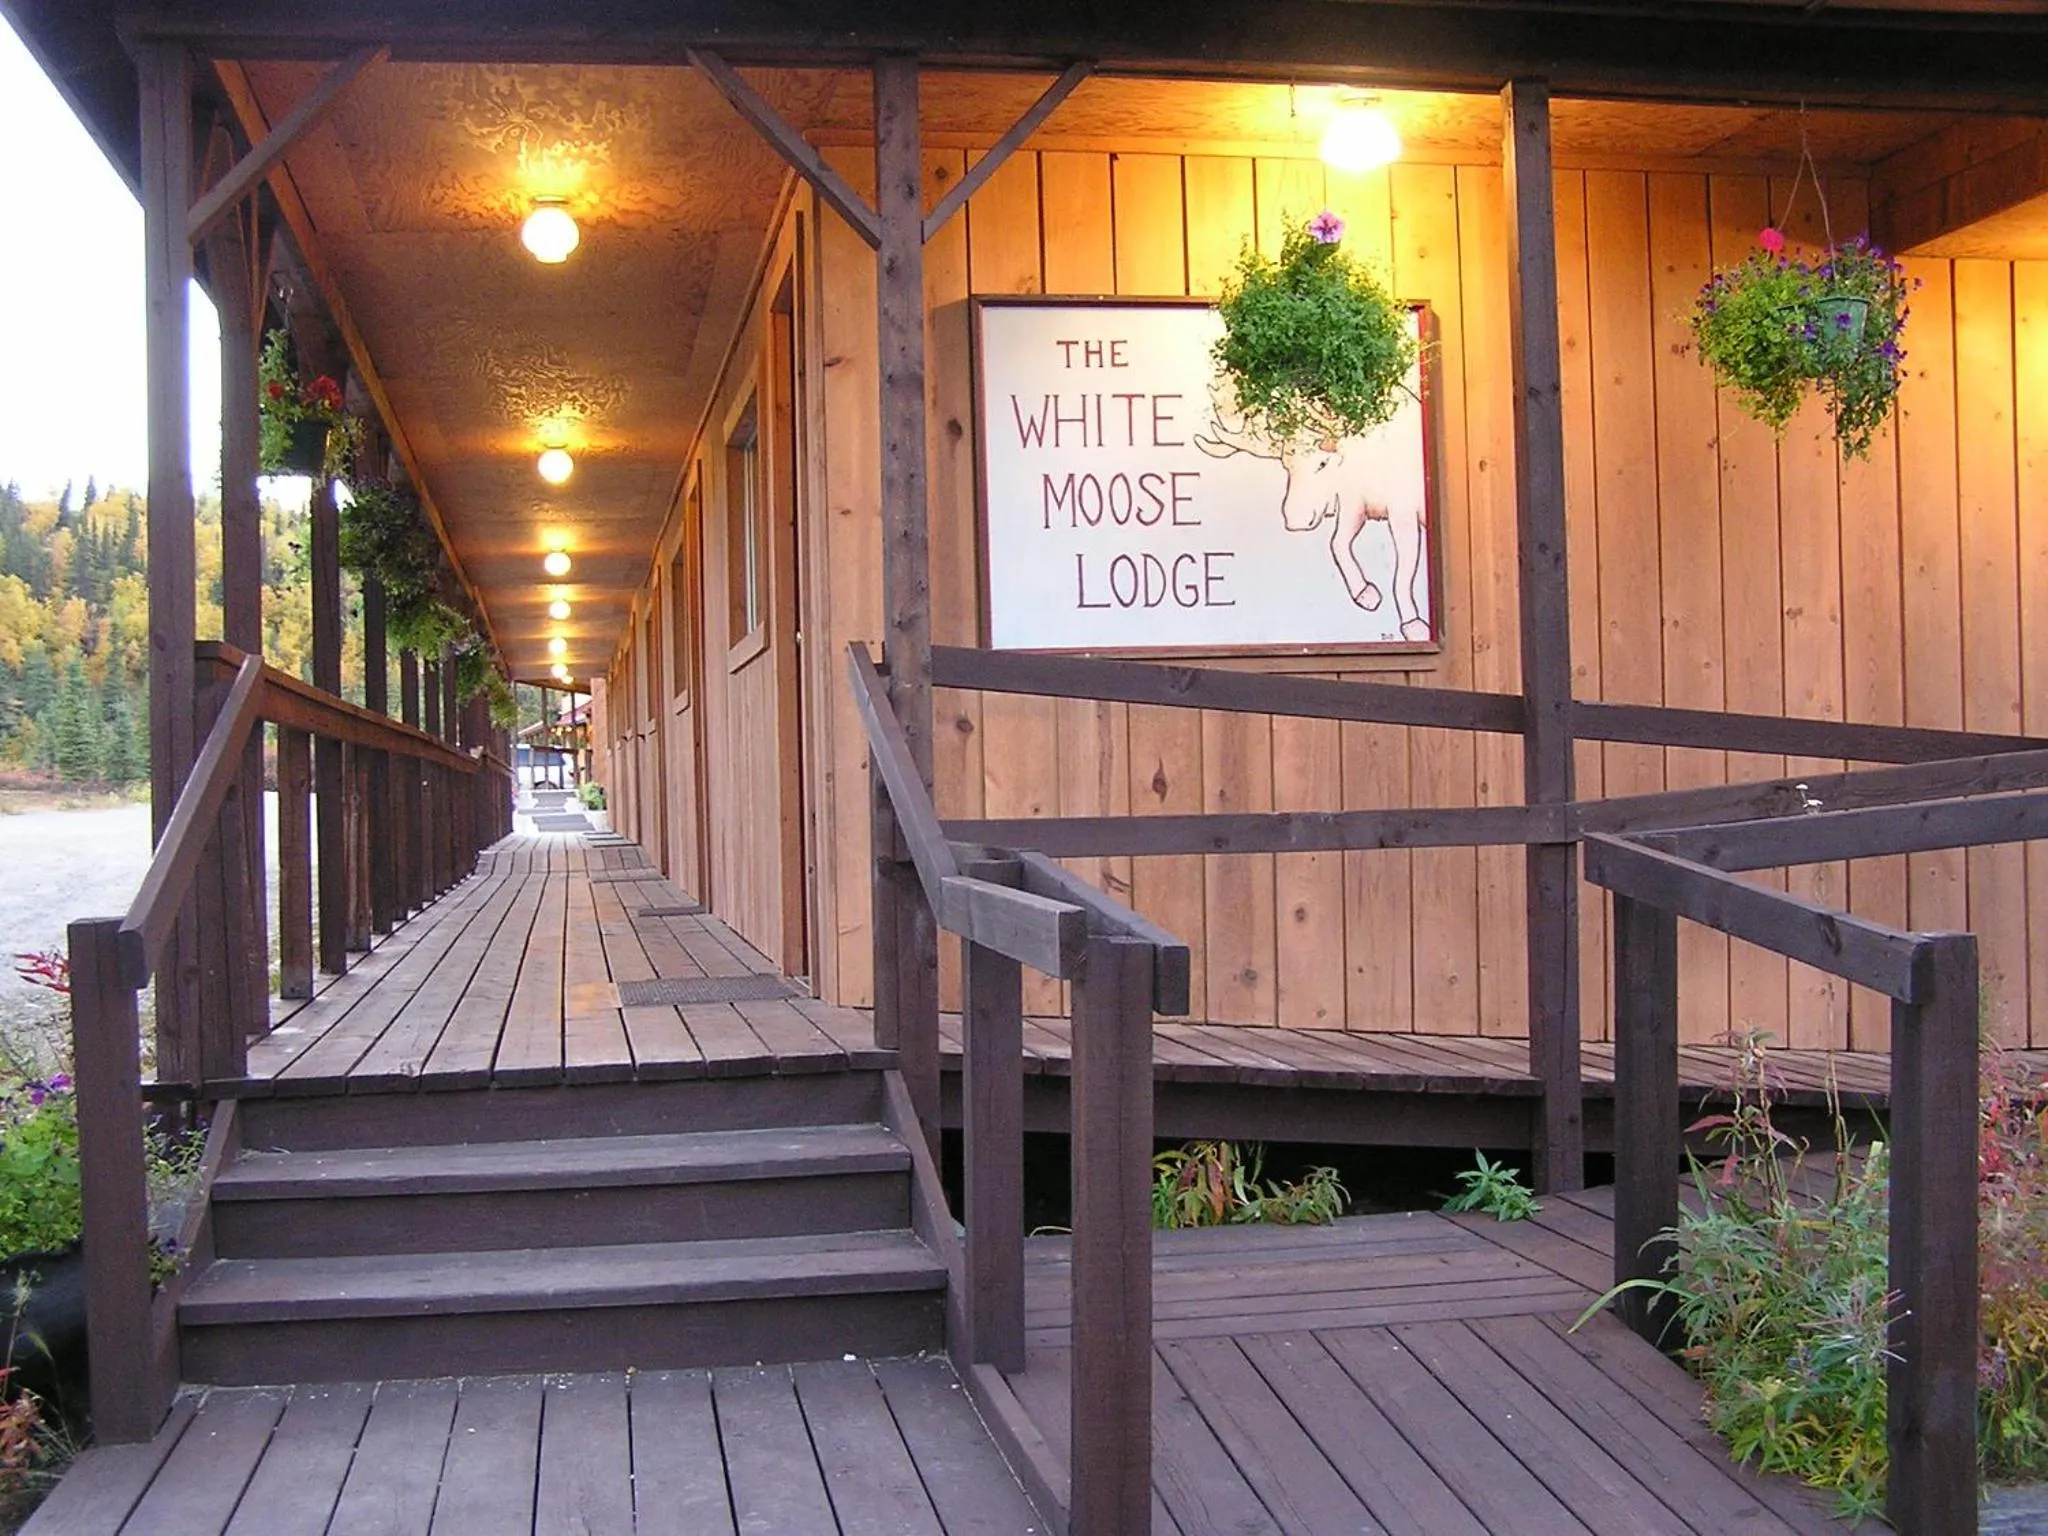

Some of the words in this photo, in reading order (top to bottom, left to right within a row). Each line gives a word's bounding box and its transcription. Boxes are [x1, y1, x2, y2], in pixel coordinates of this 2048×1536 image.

[1056, 340, 1128, 368] THE
[1010, 394, 1184, 448] WHITE
[1043, 472, 1201, 529] MOOSE
[1076, 552, 1236, 608] LODGE
